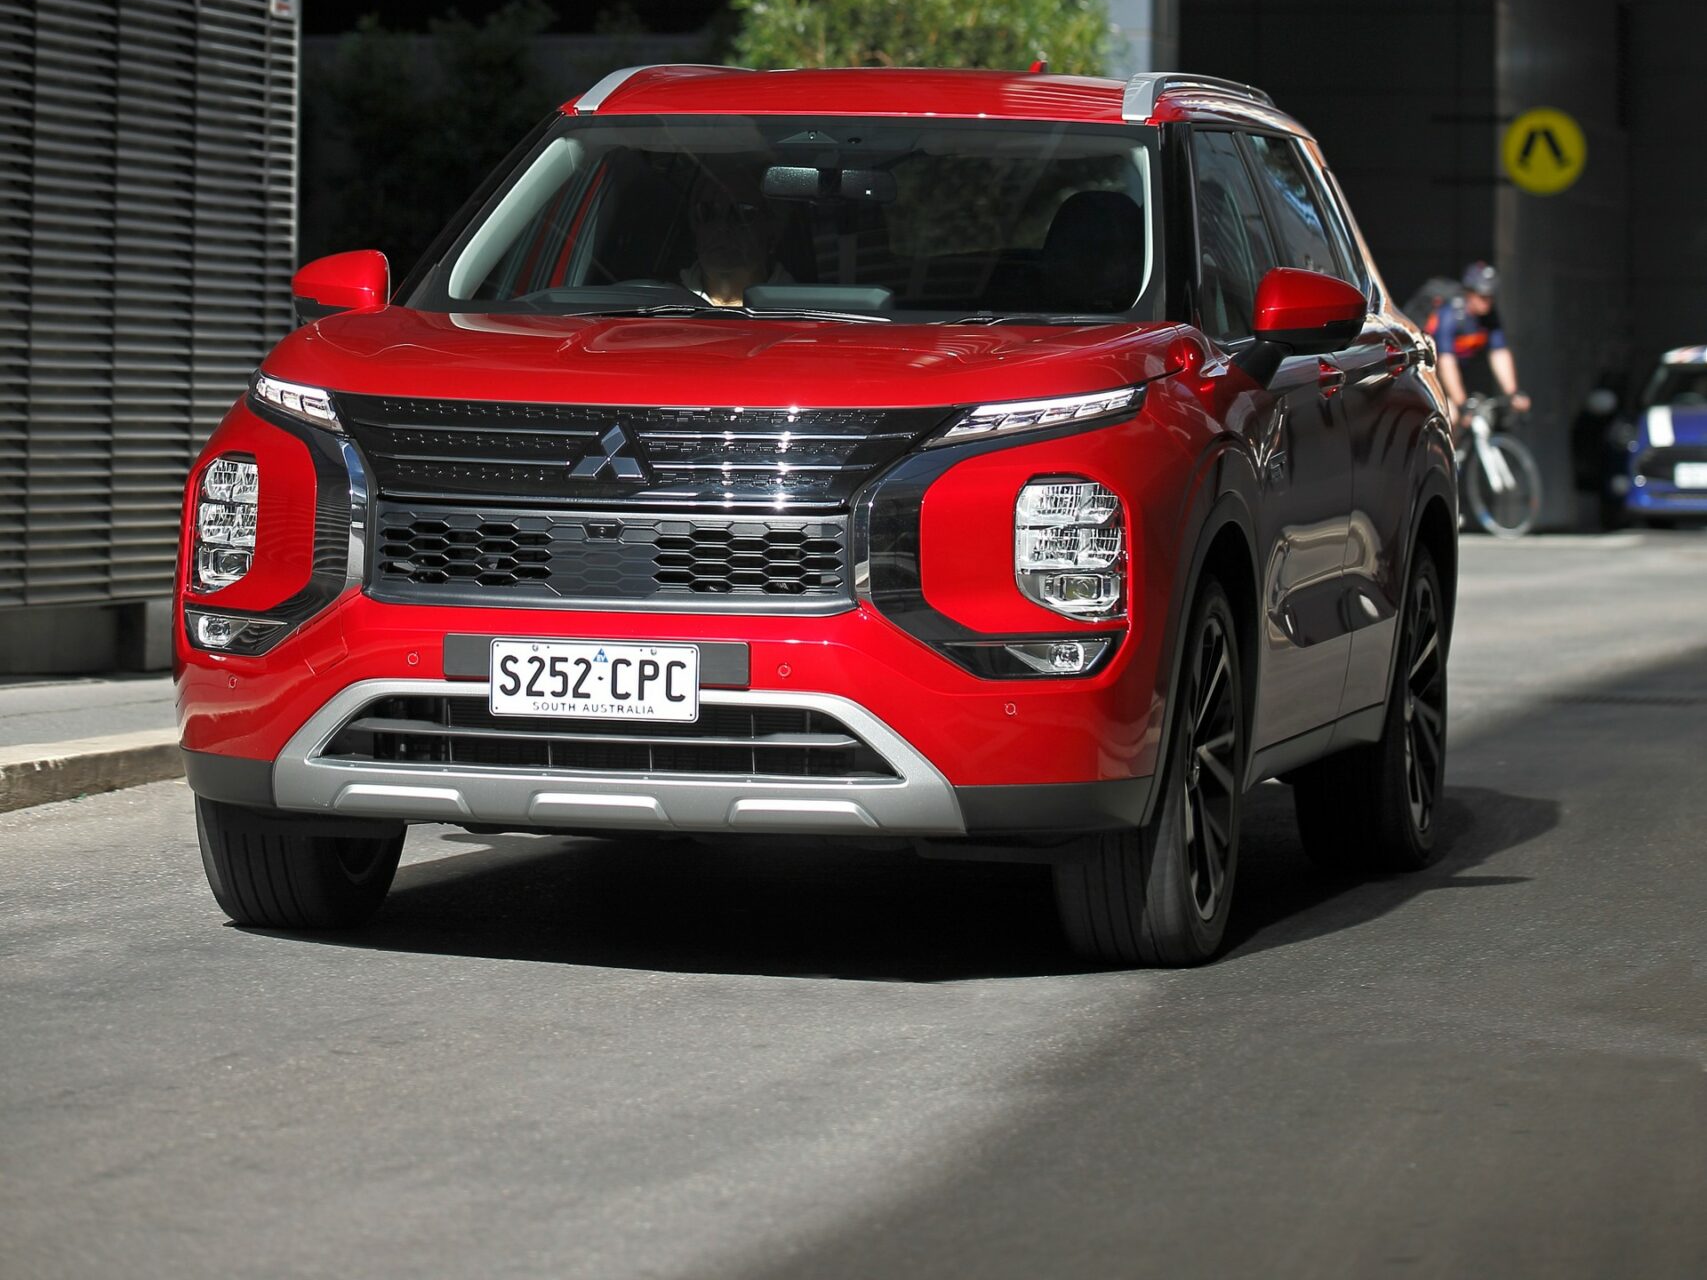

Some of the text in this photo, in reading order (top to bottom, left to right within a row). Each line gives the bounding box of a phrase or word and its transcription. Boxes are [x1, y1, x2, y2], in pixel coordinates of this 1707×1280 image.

[499, 654, 687, 702] S252 CPC
[532, 701, 655, 715] SOUTH AUSTRALIA
